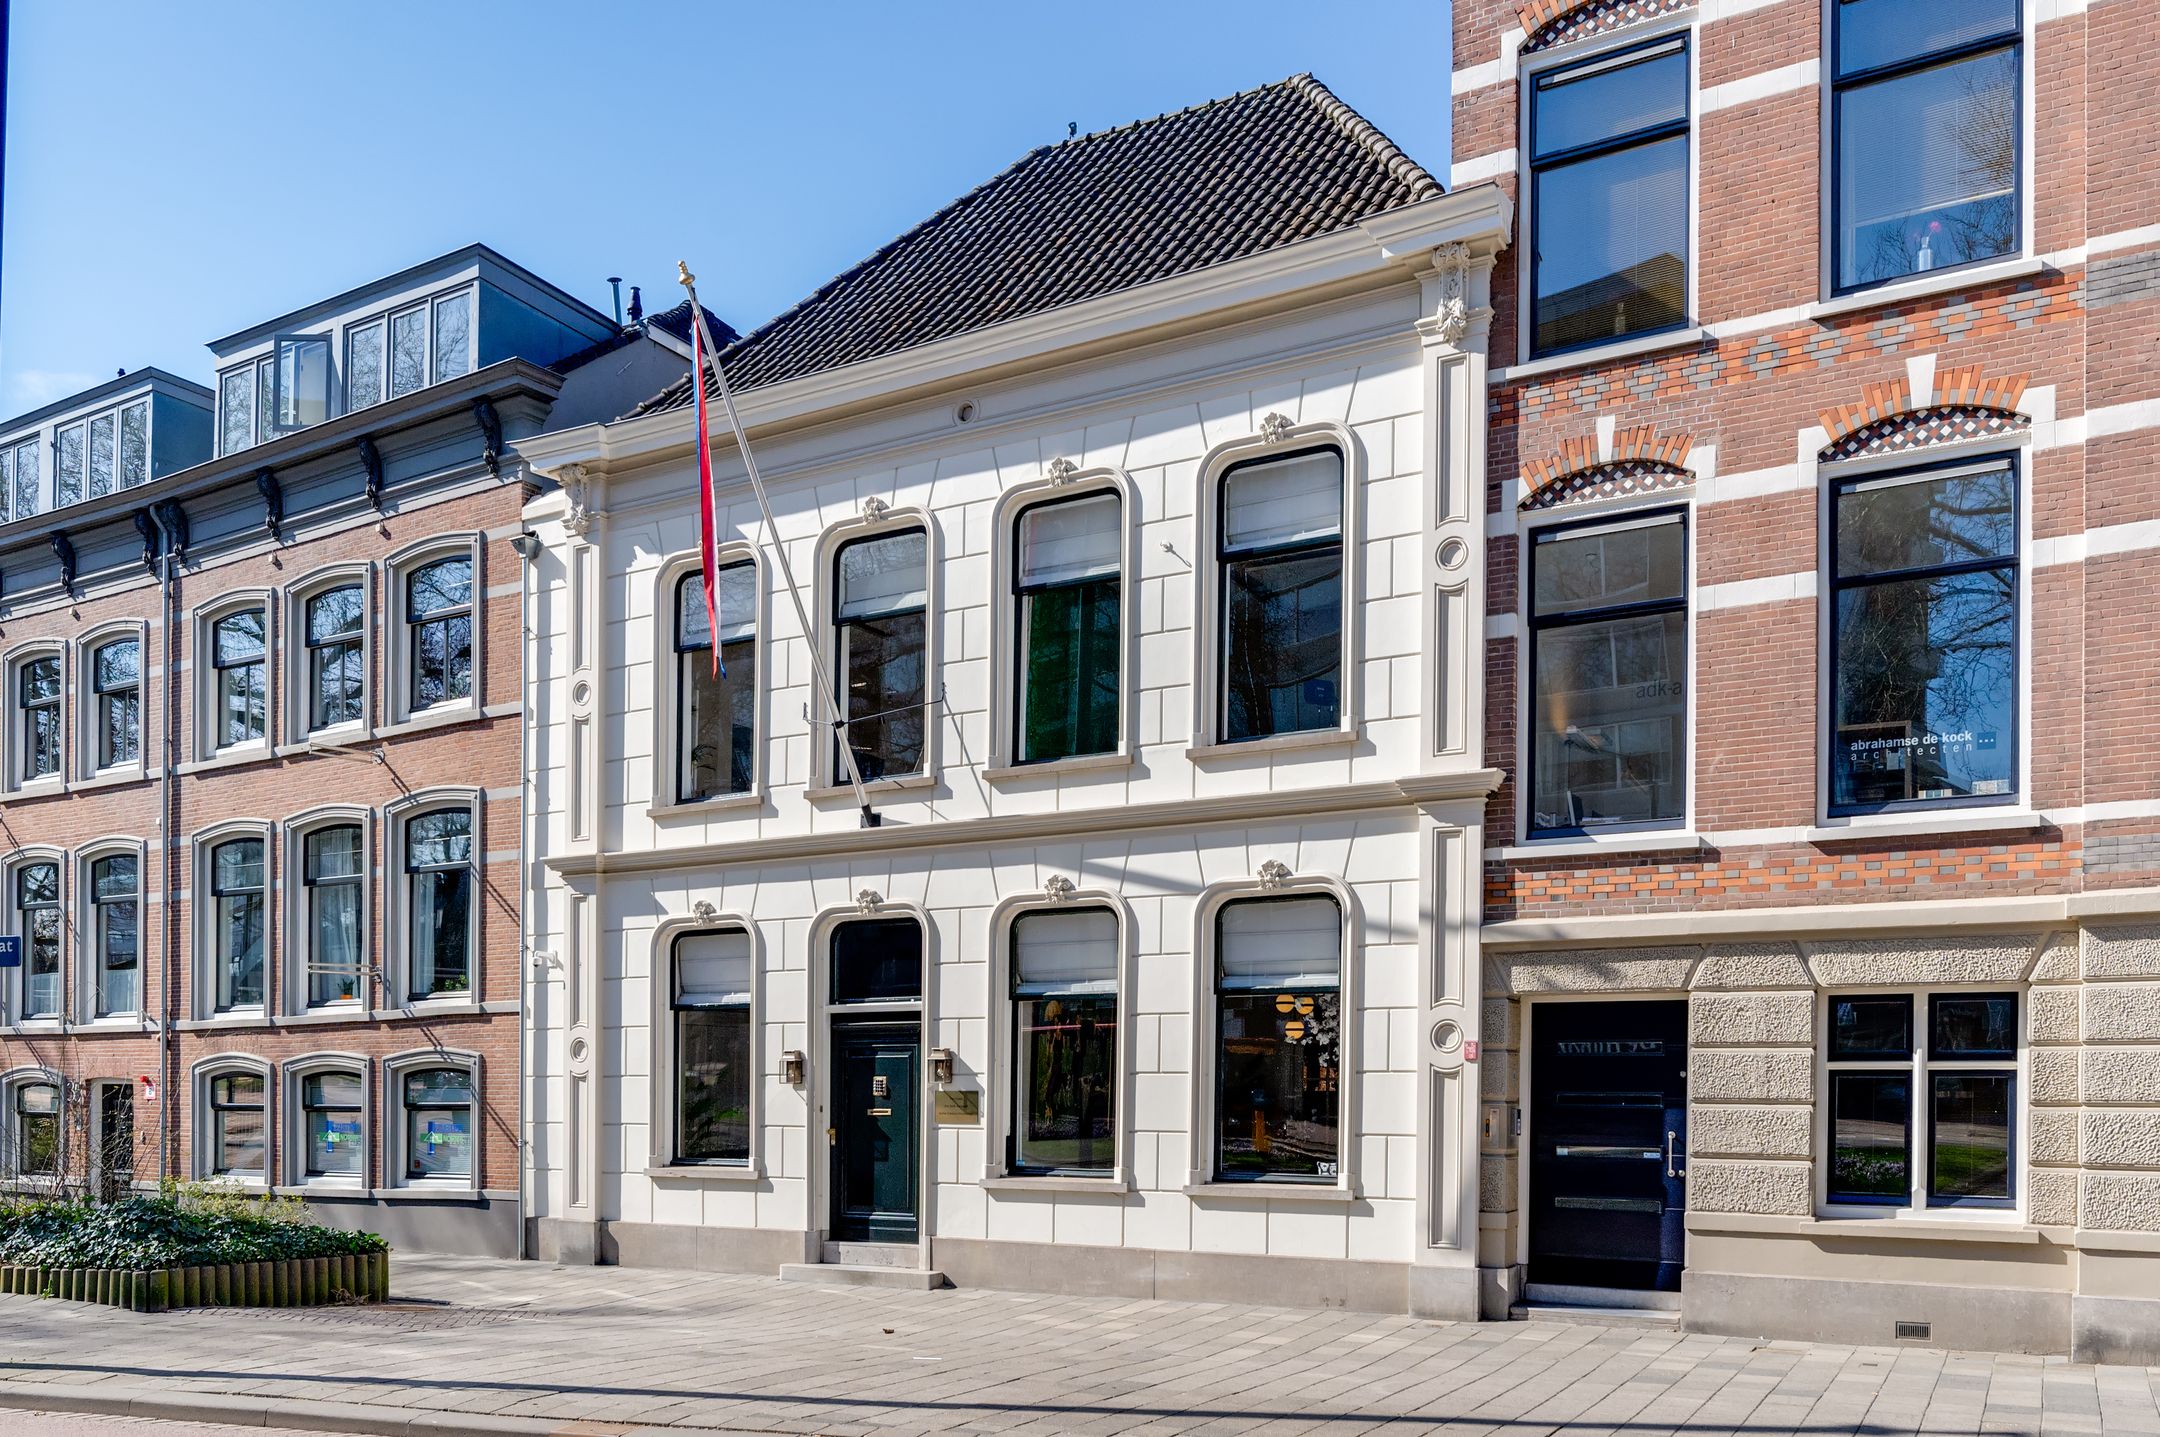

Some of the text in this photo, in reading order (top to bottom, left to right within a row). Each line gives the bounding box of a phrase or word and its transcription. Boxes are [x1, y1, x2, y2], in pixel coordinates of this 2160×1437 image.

[1850, 730, 1972, 751] abrahamse de kock
[1850, 743, 1973, 761] architecten
